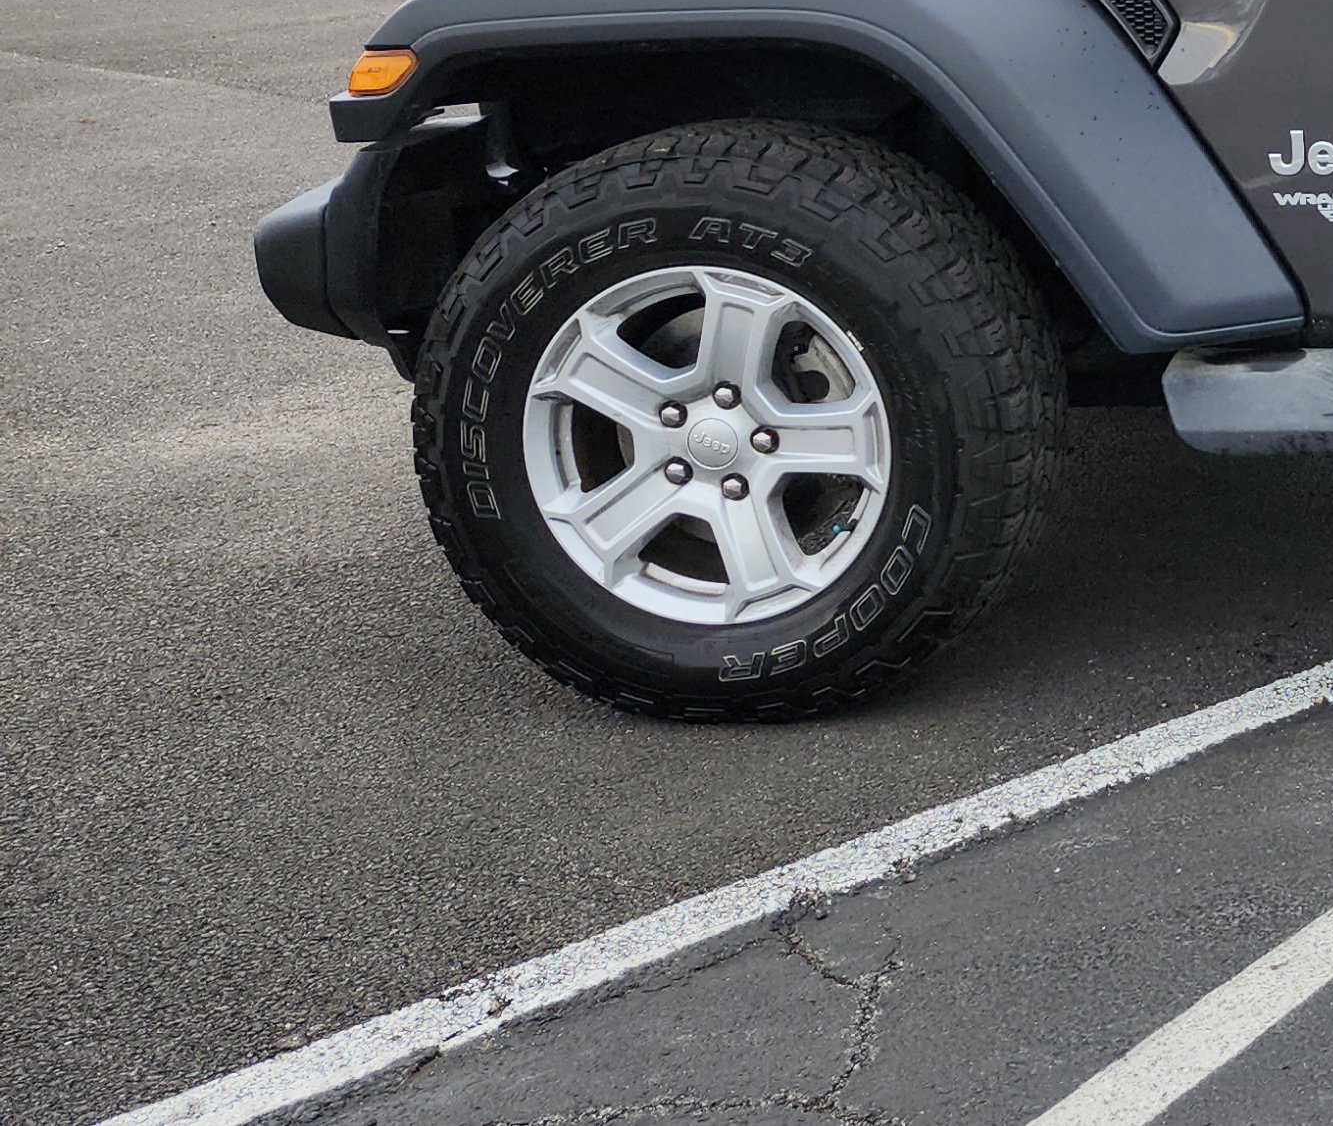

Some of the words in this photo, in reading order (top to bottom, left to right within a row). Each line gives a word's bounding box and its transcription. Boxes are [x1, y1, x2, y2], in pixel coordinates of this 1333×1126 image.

[458, 216, 659, 520] DISCOVERER
[688, 216, 813, 268] AT3
[693, 431, 731, 455] Jeep
[717, 502, 933, 683] COOPER
